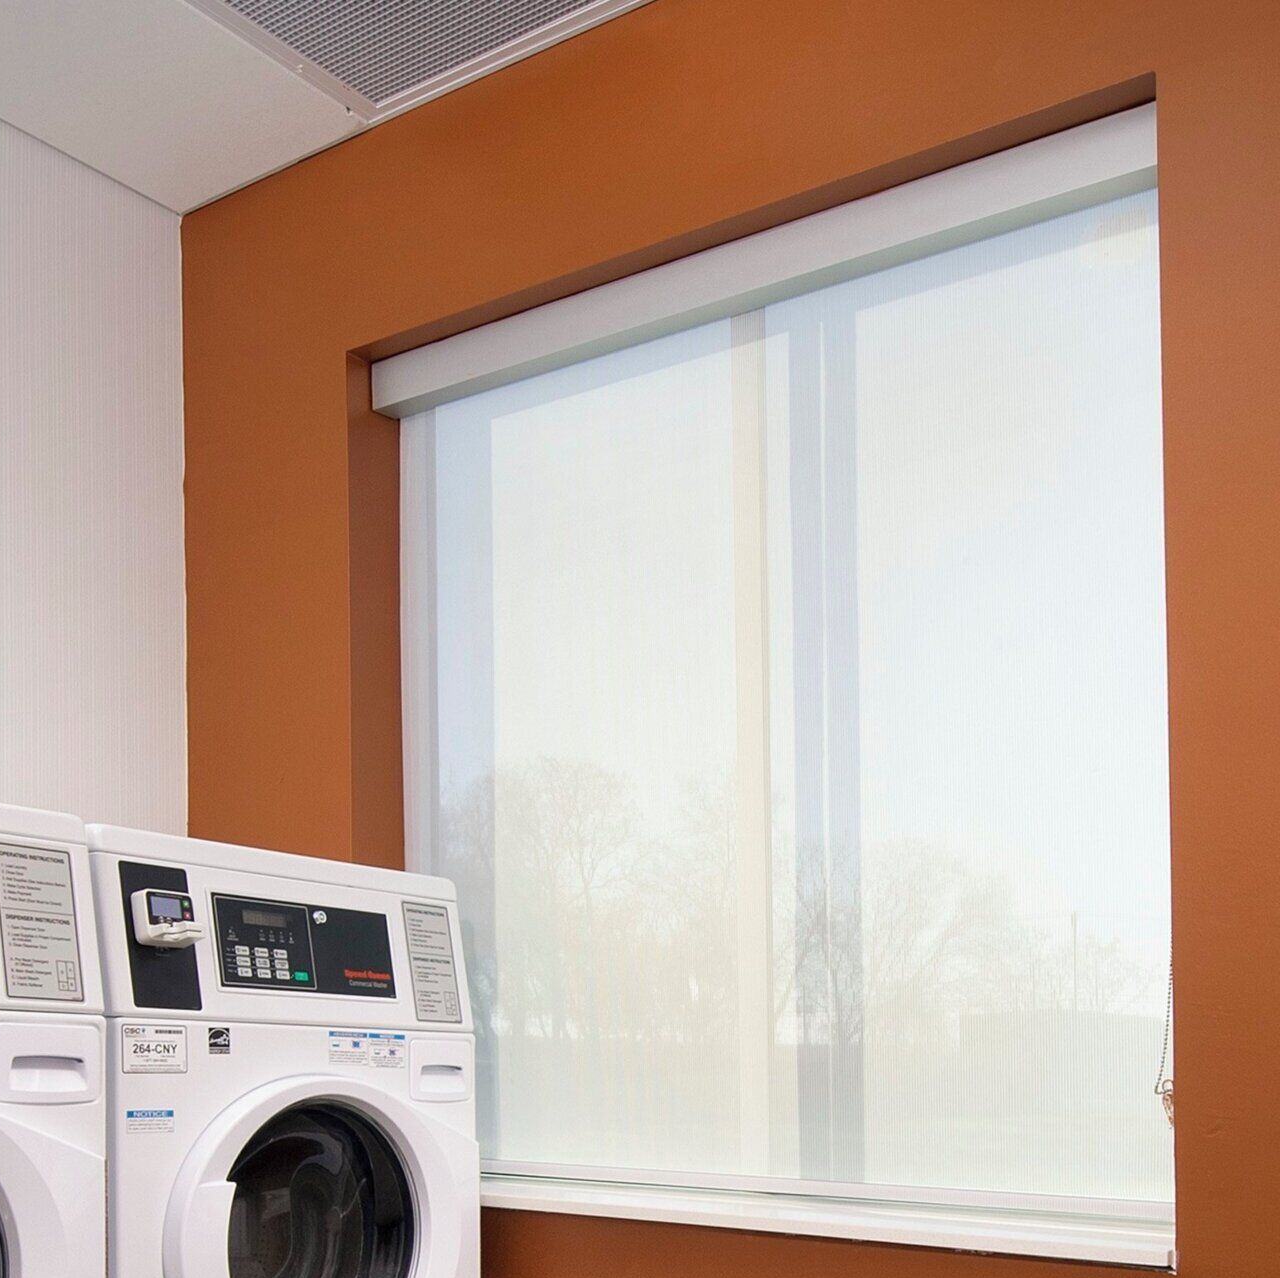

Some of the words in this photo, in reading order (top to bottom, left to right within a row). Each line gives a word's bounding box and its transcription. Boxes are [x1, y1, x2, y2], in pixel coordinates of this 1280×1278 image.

[0, 850, 28, 859] OPERATING
[29, 854, 65, 864] INSTRUCTIONS
[35, 917, 71, 925] INSTRUCTIONS
[132, 1043, 177, 1054] 264-CNY
